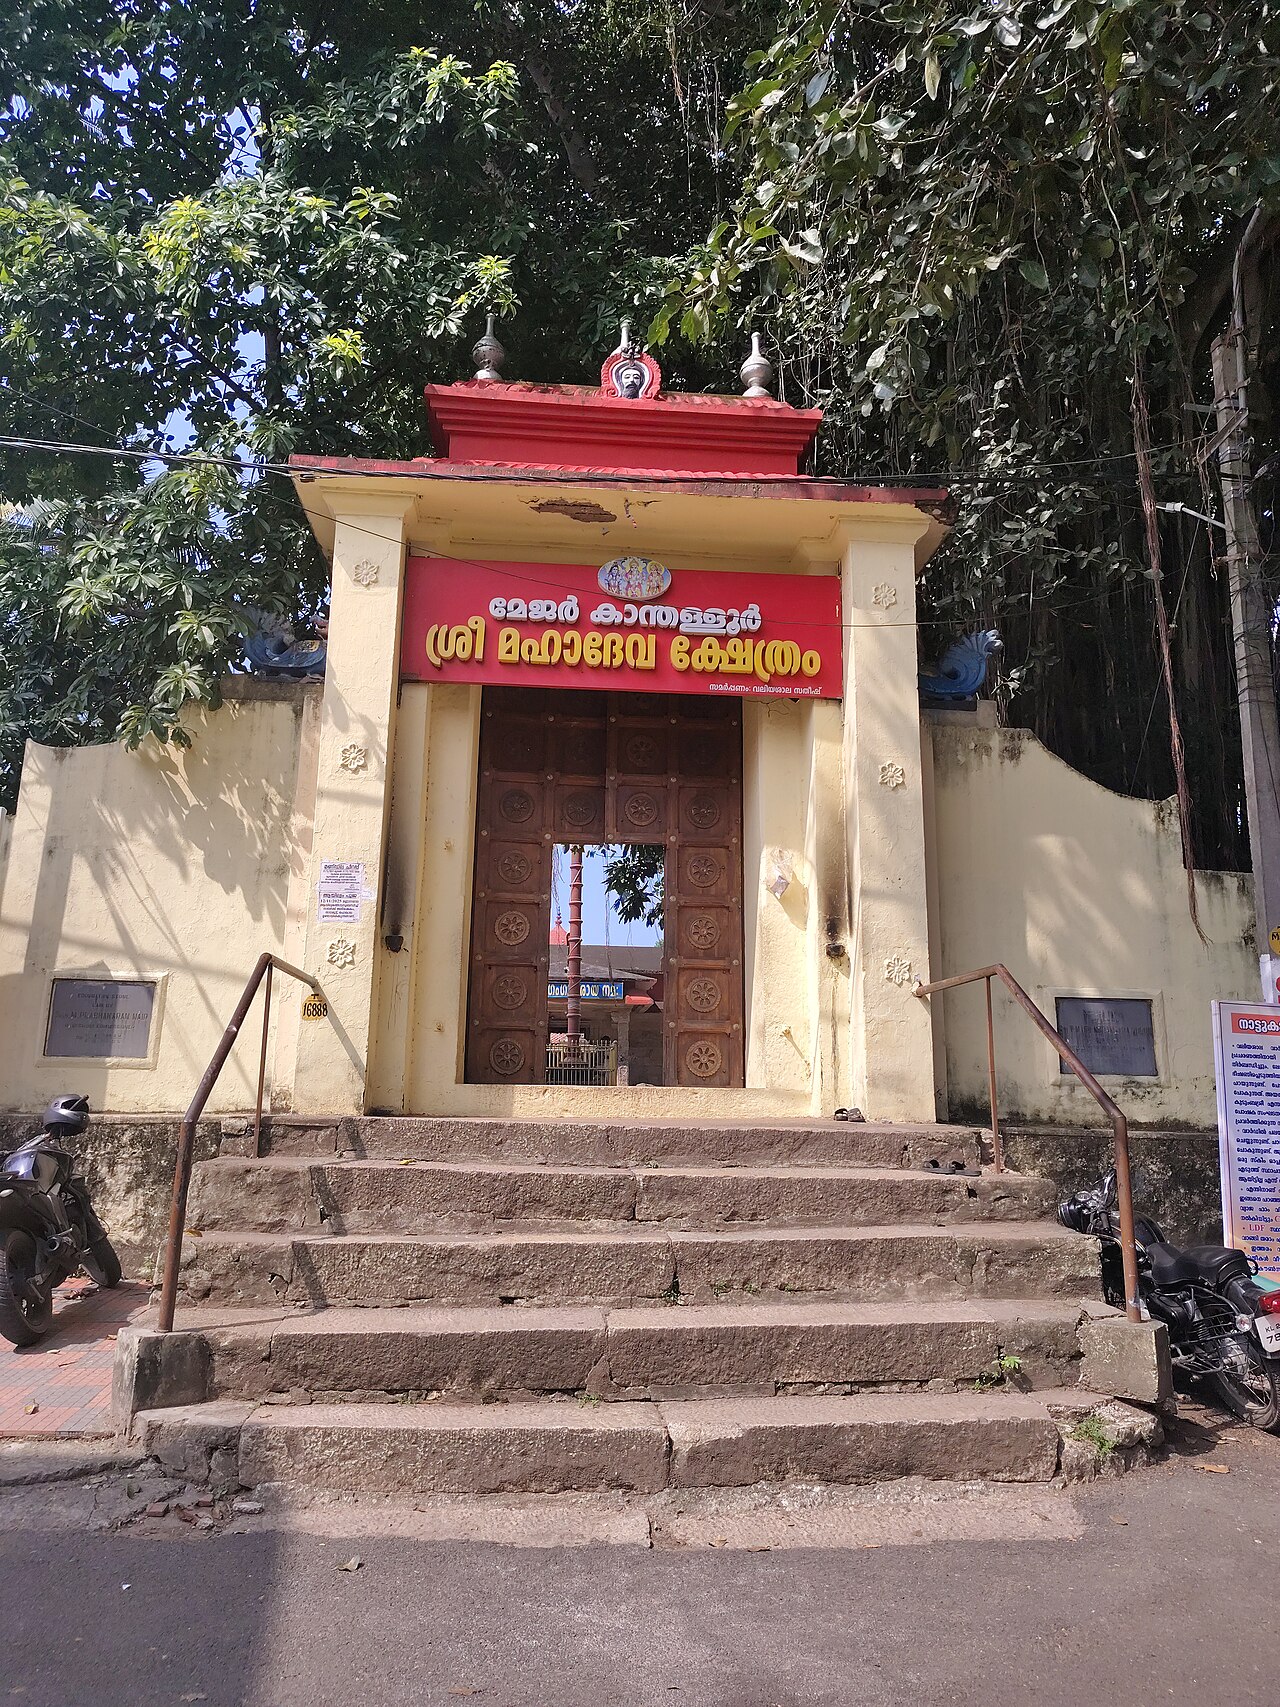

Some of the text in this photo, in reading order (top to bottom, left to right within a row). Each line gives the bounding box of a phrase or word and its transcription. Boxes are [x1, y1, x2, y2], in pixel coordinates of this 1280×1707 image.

[488, 595, 762, 637] മേജർ കാന്തള്ളൂർ
[425, 615, 822, 683] ശ്രീ മഹാദേവ ക്ഷേത്രം
[752, 684, 792, 694] വലിയശാല
[1249, 1224, 1266, 1232] LDF
